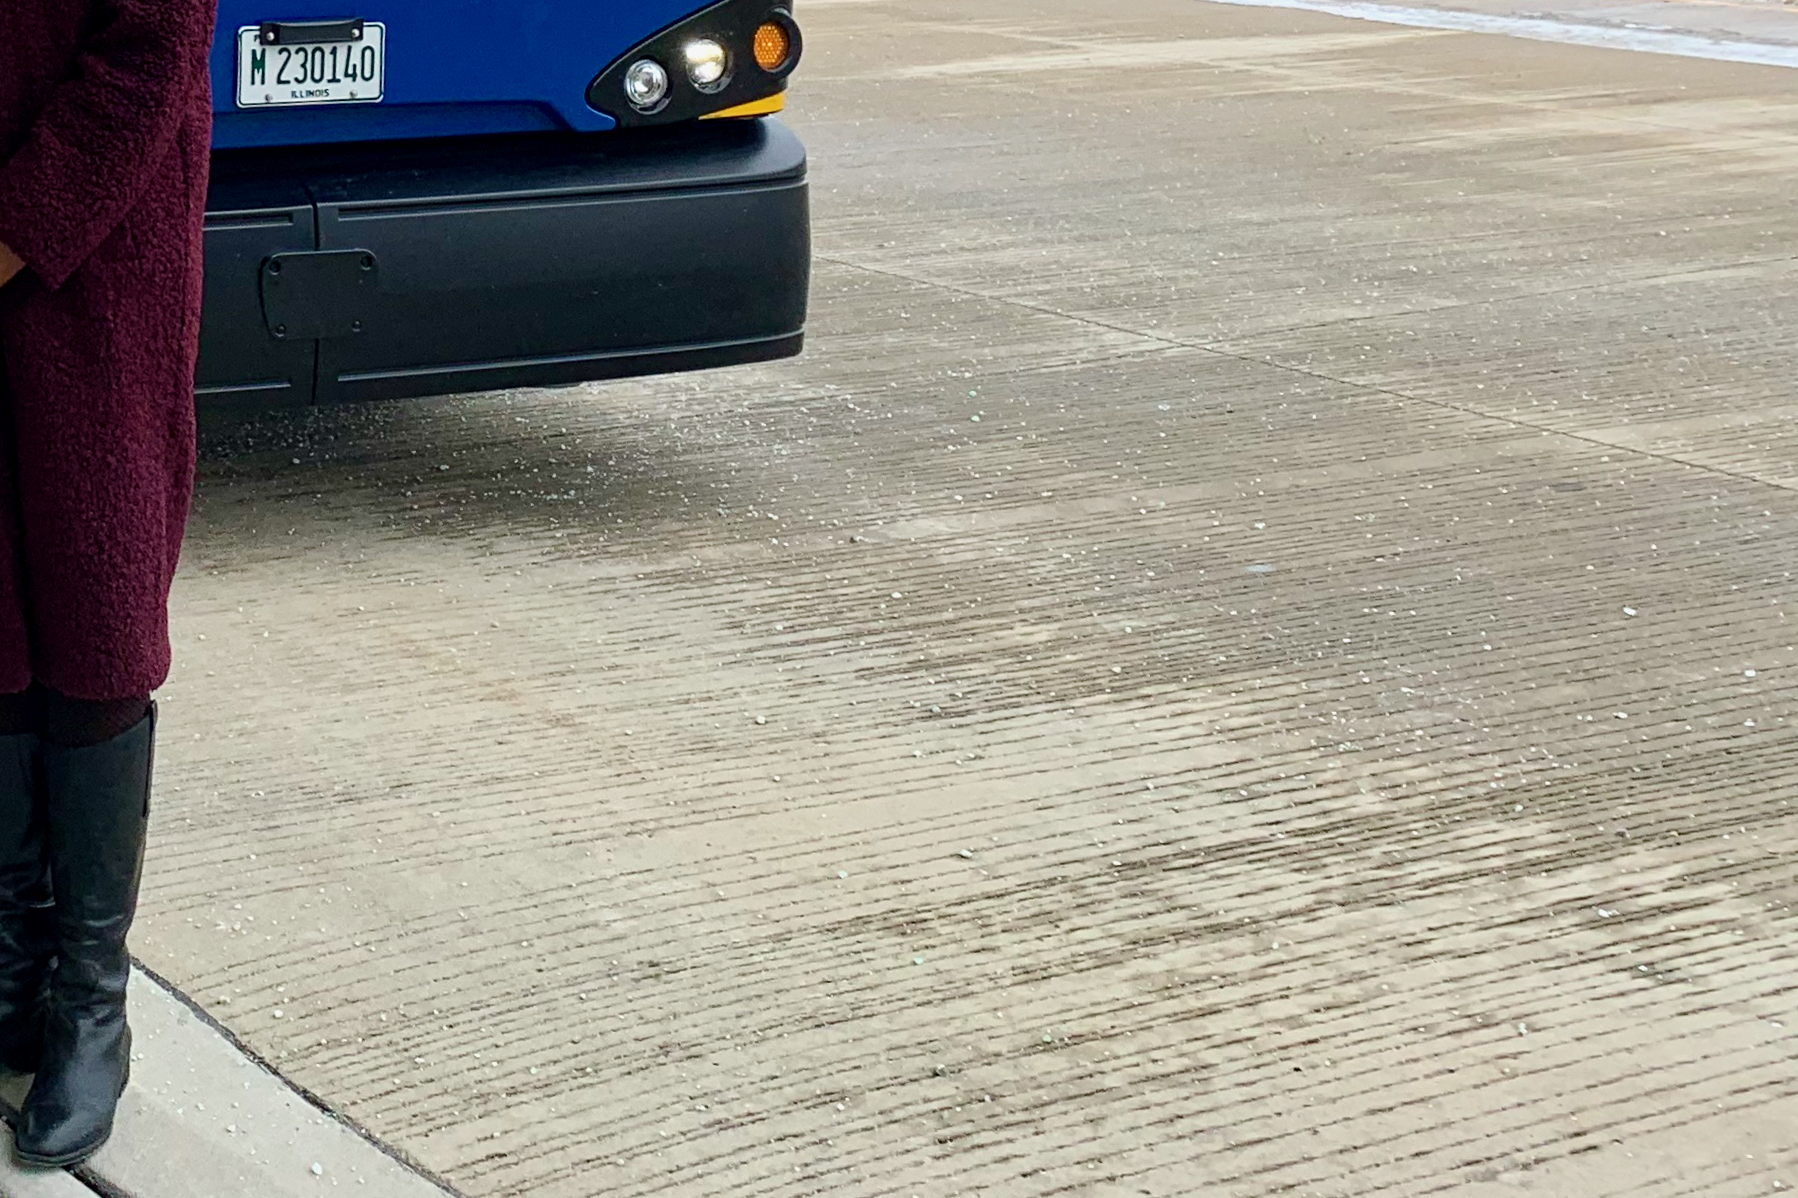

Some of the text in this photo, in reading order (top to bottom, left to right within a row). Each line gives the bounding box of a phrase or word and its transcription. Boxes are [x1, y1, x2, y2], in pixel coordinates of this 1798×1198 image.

[251, 45, 375, 86] M 230140
[291, 89, 330, 99] ILLINOIS
